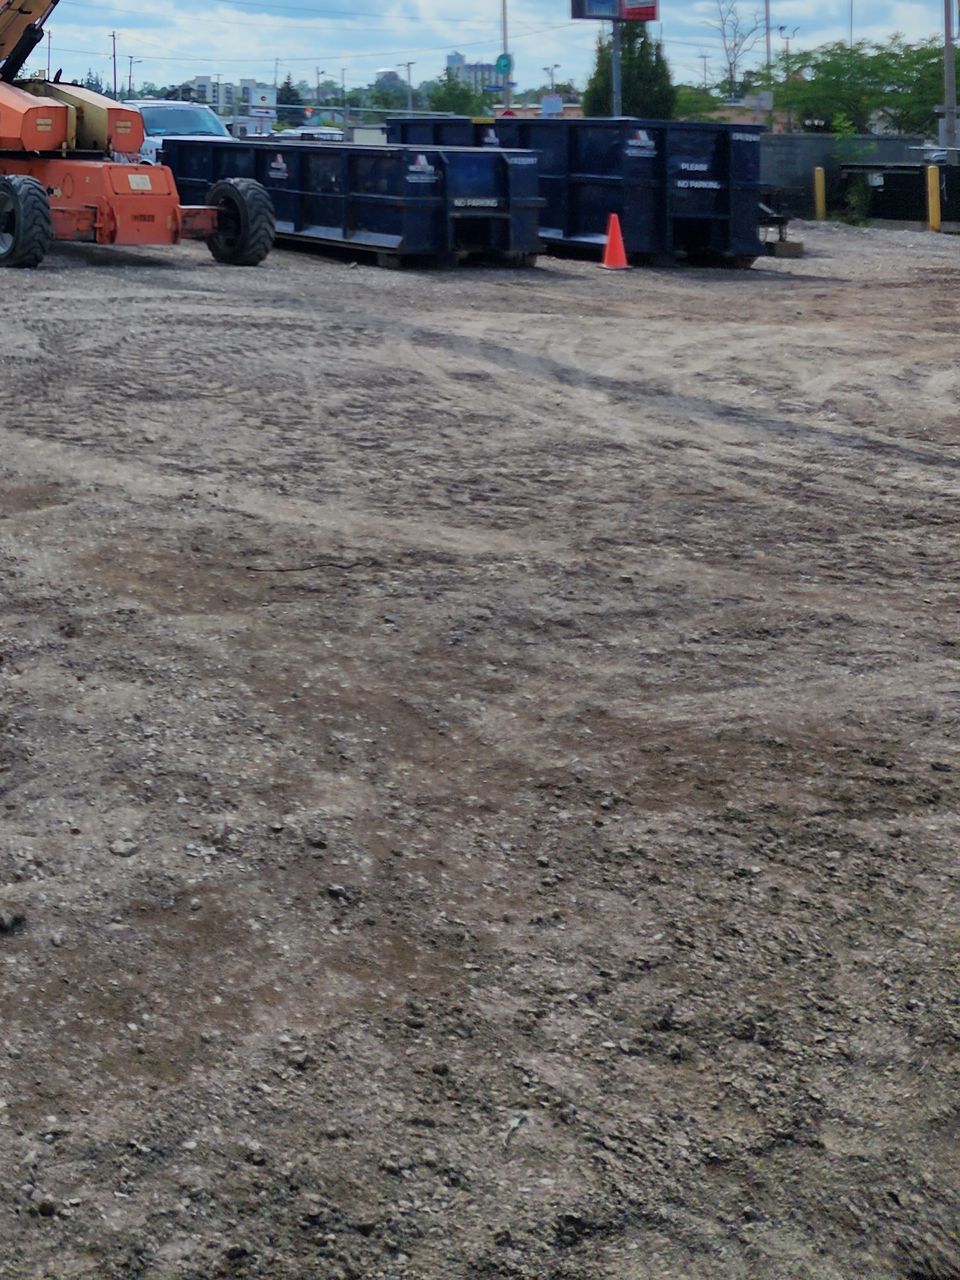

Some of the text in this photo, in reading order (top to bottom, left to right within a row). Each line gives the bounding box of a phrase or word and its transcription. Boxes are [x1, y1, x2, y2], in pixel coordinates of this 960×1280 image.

[681, 162, 708, 171] PLEASE
[677, 180, 721, 189] NO PARKING
[454, 199, 498, 207] NO PARKING
